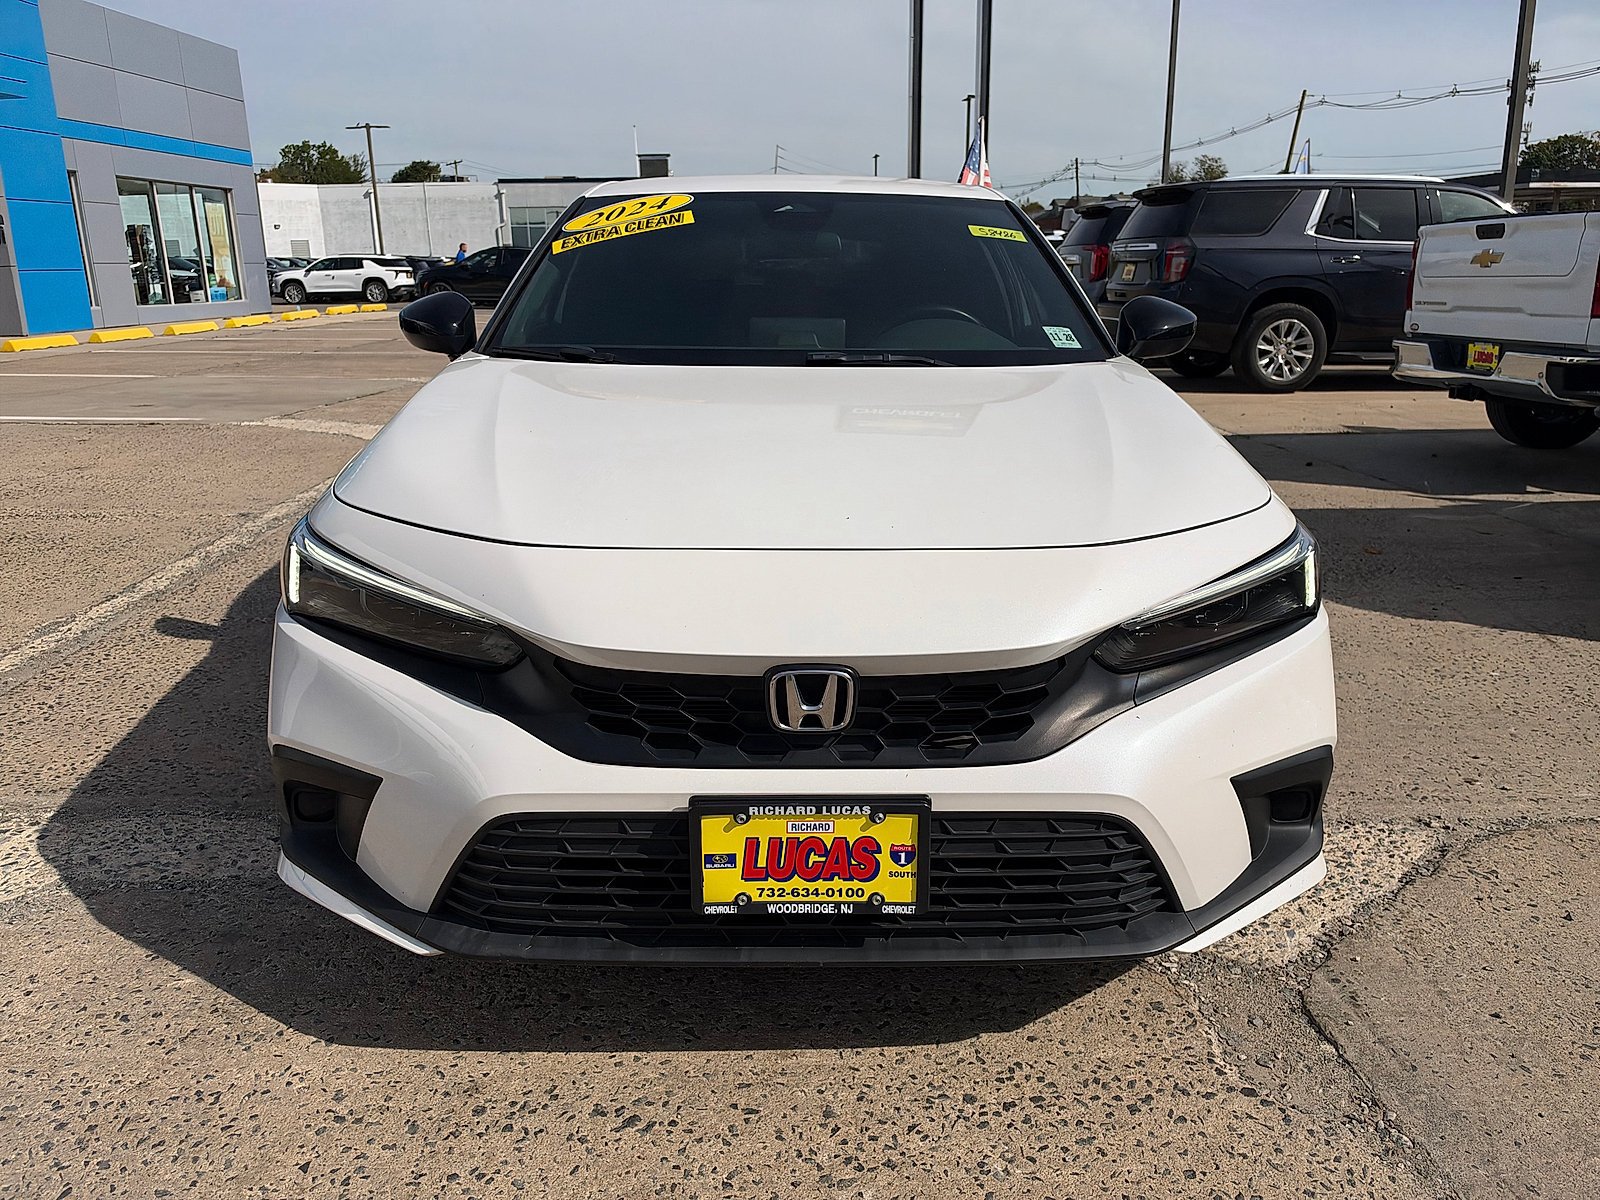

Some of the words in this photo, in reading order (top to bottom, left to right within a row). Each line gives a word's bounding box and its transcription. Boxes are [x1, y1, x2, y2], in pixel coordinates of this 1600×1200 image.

[582, 195, 672, 229] 2024
[560, 226, 622, 250] EXTRA
[624, 212, 685, 233] CLEAN
[748, 805, 817, 816] RICHARD
[821, 805, 872, 816] LUCAS
[790, 822, 831, 832] RICHARD
[741, 836, 882, 882] LUCAS
[897, 851, 908, 865] 1
[888, 870, 917, 879] SOUTH
[756, 887, 865, 898] 732-634-0100
[703, 905, 738, 914] CHEVROLET
[767, 903, 838, 914] WOODBRIDGE,
[840, 903, 854, 914] NJ
[881, 904, 916, 914] CHEVROLET
